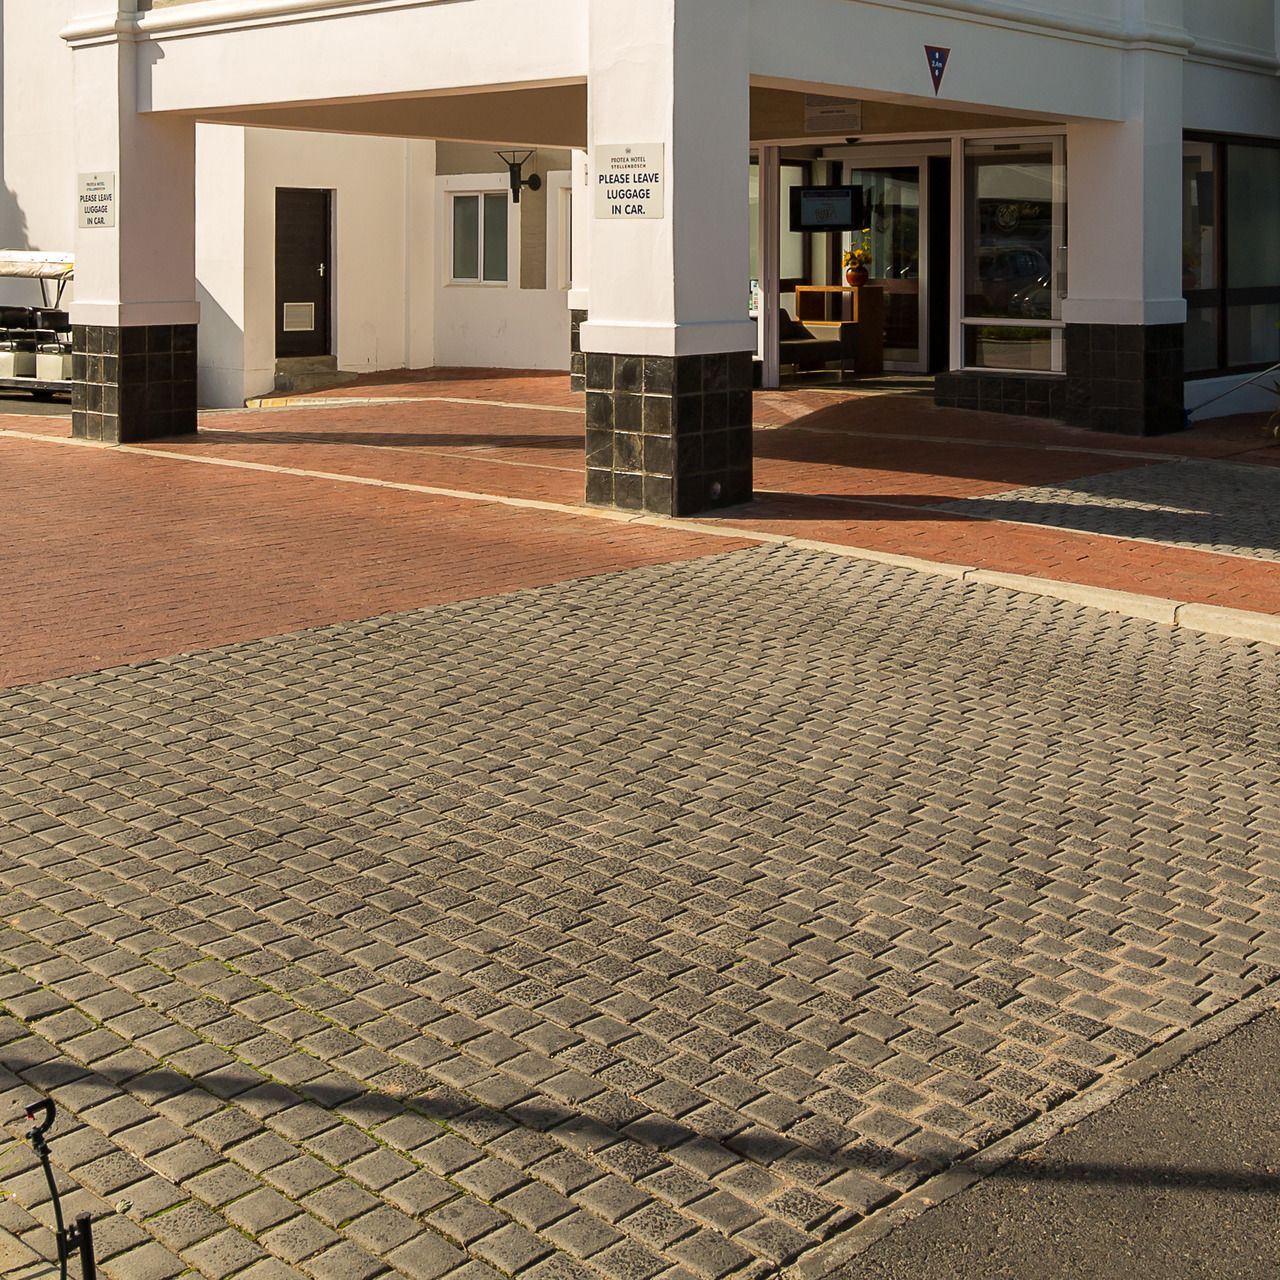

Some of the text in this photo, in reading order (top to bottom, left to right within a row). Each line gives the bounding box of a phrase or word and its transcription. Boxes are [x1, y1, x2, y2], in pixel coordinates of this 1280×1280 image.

[598, 173, 660, 184] PLEASE LEAVE
[80, 193, 112, 202] PLEASE LEAVE
[607, 189, 651, 199] LUGGAGE
[84, 205, 108, 214] LUGGAGE
[611, 204, 646, 215] IN CAR.
